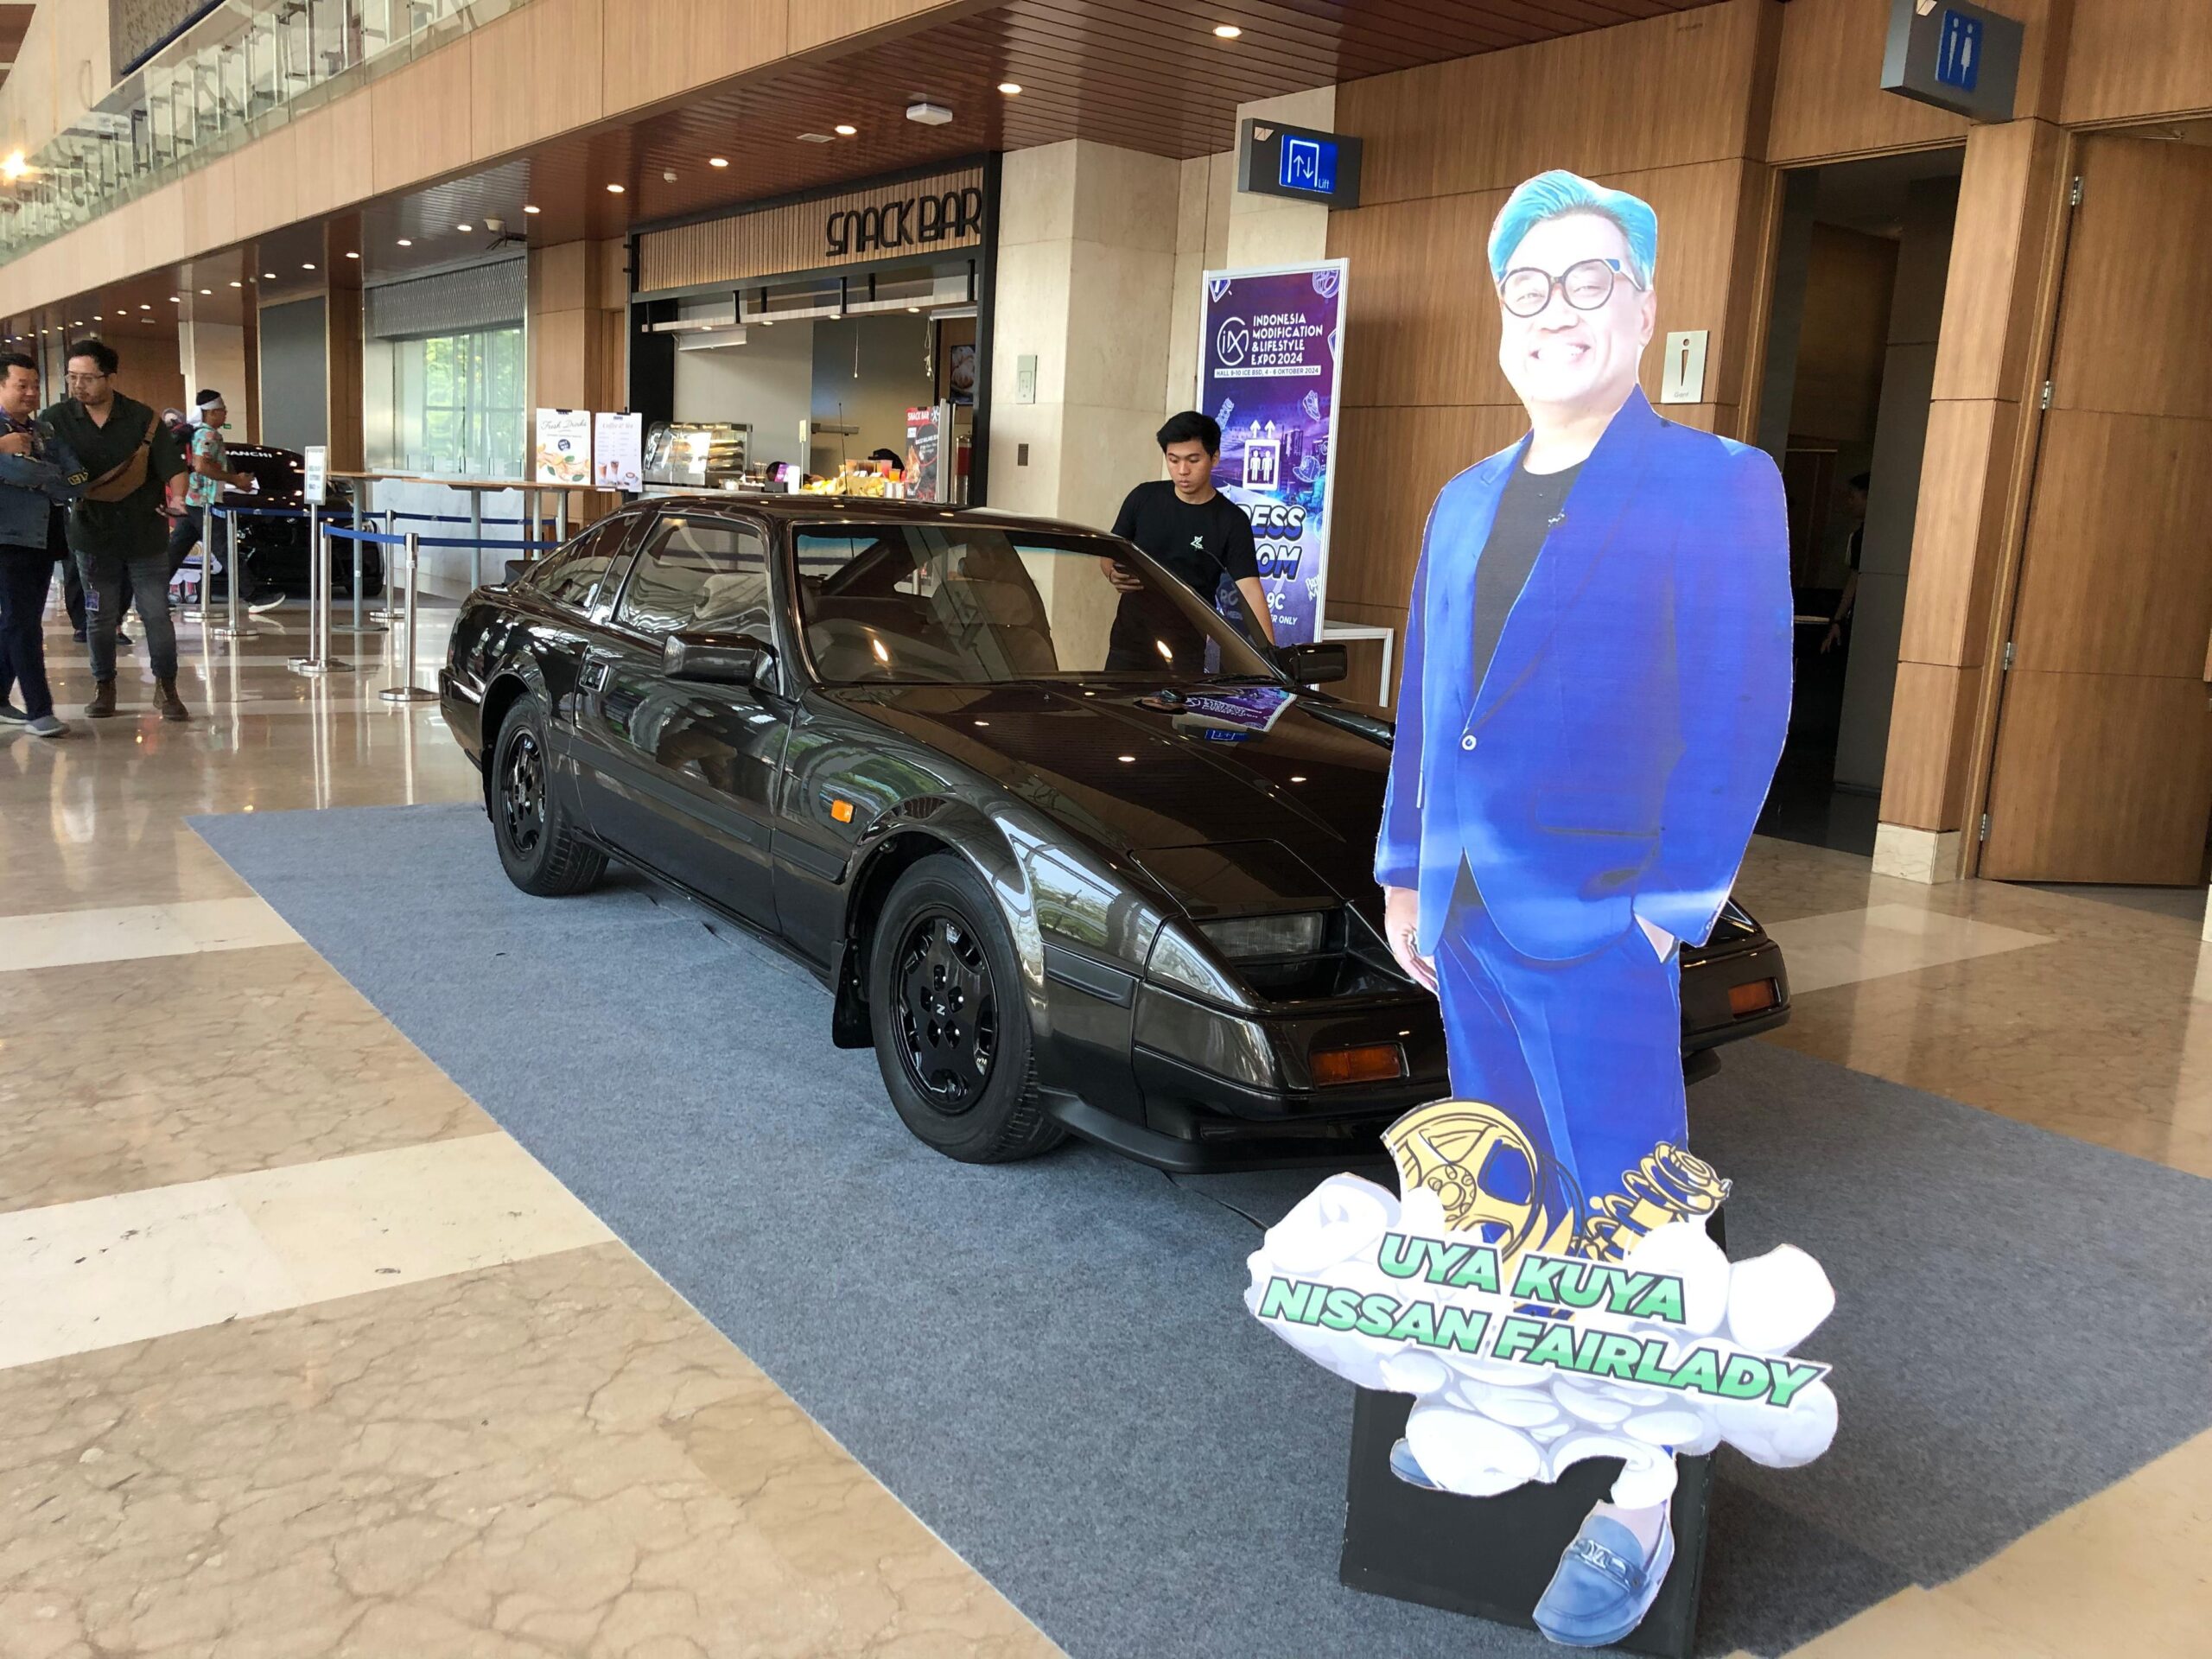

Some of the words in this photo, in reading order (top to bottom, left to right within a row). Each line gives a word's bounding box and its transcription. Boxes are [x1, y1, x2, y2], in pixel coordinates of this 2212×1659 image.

[1318, 178, 1329, 189] Lift
[826, 198, 915, 257] SNACK
[918, 188, 982, 243] BAR
[1252, 325, 1323, 340] MODIFICATION
[1253, 313, 1306, 327] INDONESIA
[1251, 354, 1276, 365] EXPO
[1278, 353, 1303, 365] 2024
[1237, 503, 1306, 541] ESS
[1255, 543, 1302, 580] OM
[1279, 615, 1298, 626] ONLY
[1377, 1233, 1501, 1294] UYA
[1513, 1254, 1687, 1325] KUYA
[1259, 1277, 1491, 1353] NISSAN
[1491, 1318, 1822, 1408] FAIRLADY
